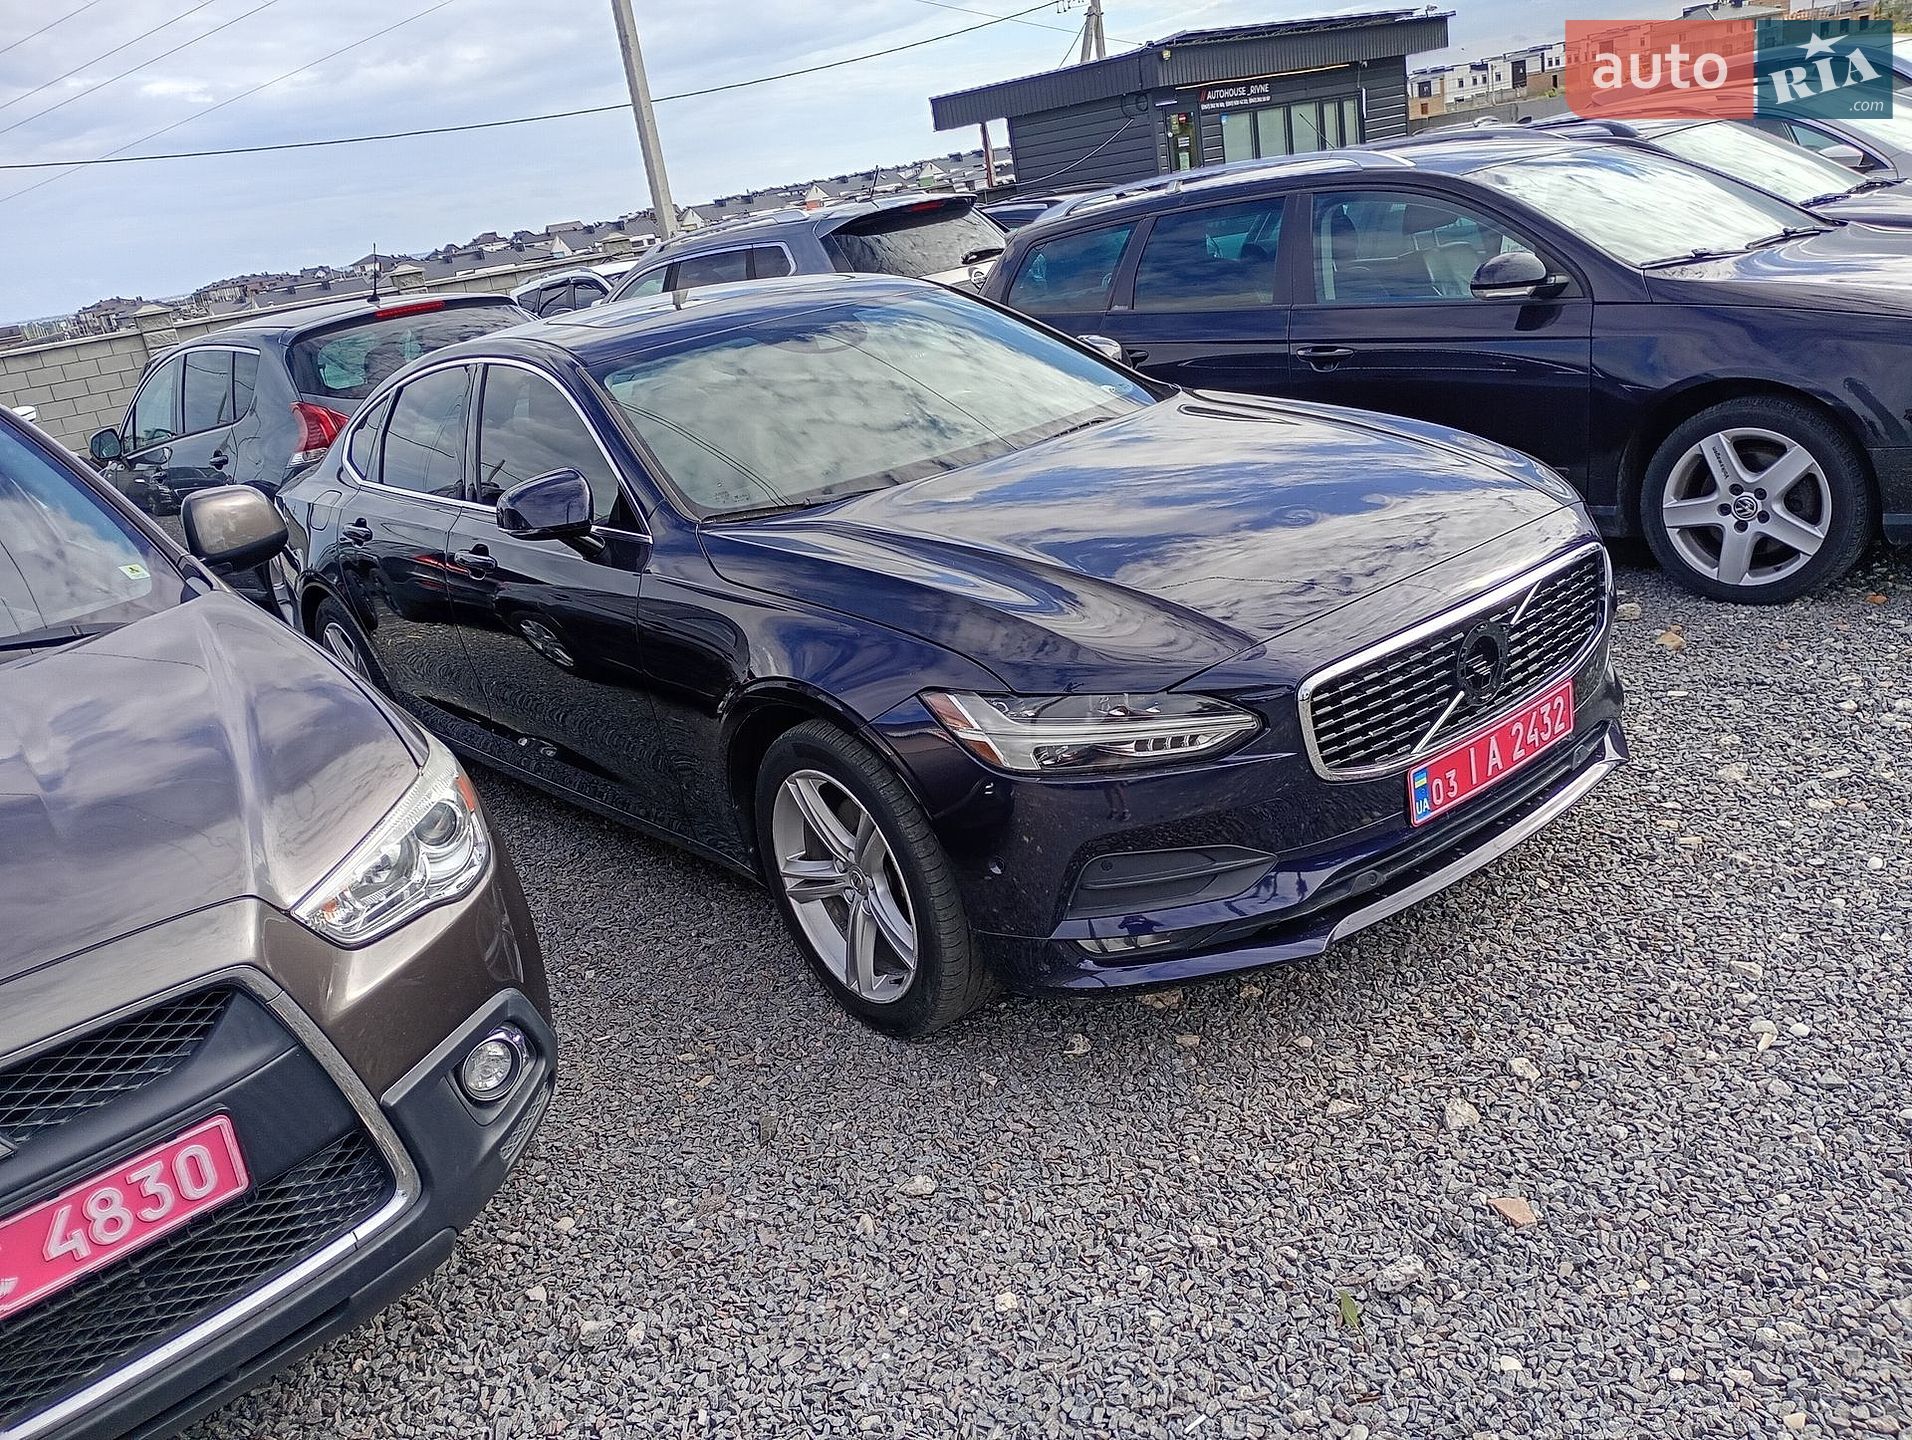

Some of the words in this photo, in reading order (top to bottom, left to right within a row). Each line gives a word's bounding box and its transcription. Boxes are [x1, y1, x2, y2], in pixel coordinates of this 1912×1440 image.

[1416, 797, 1430, 814] UA
[1431, 769, 1458, 806] 03
[1511, 696, 1567, 762] 2432
[43, 1144, 218, 1262] 4830
